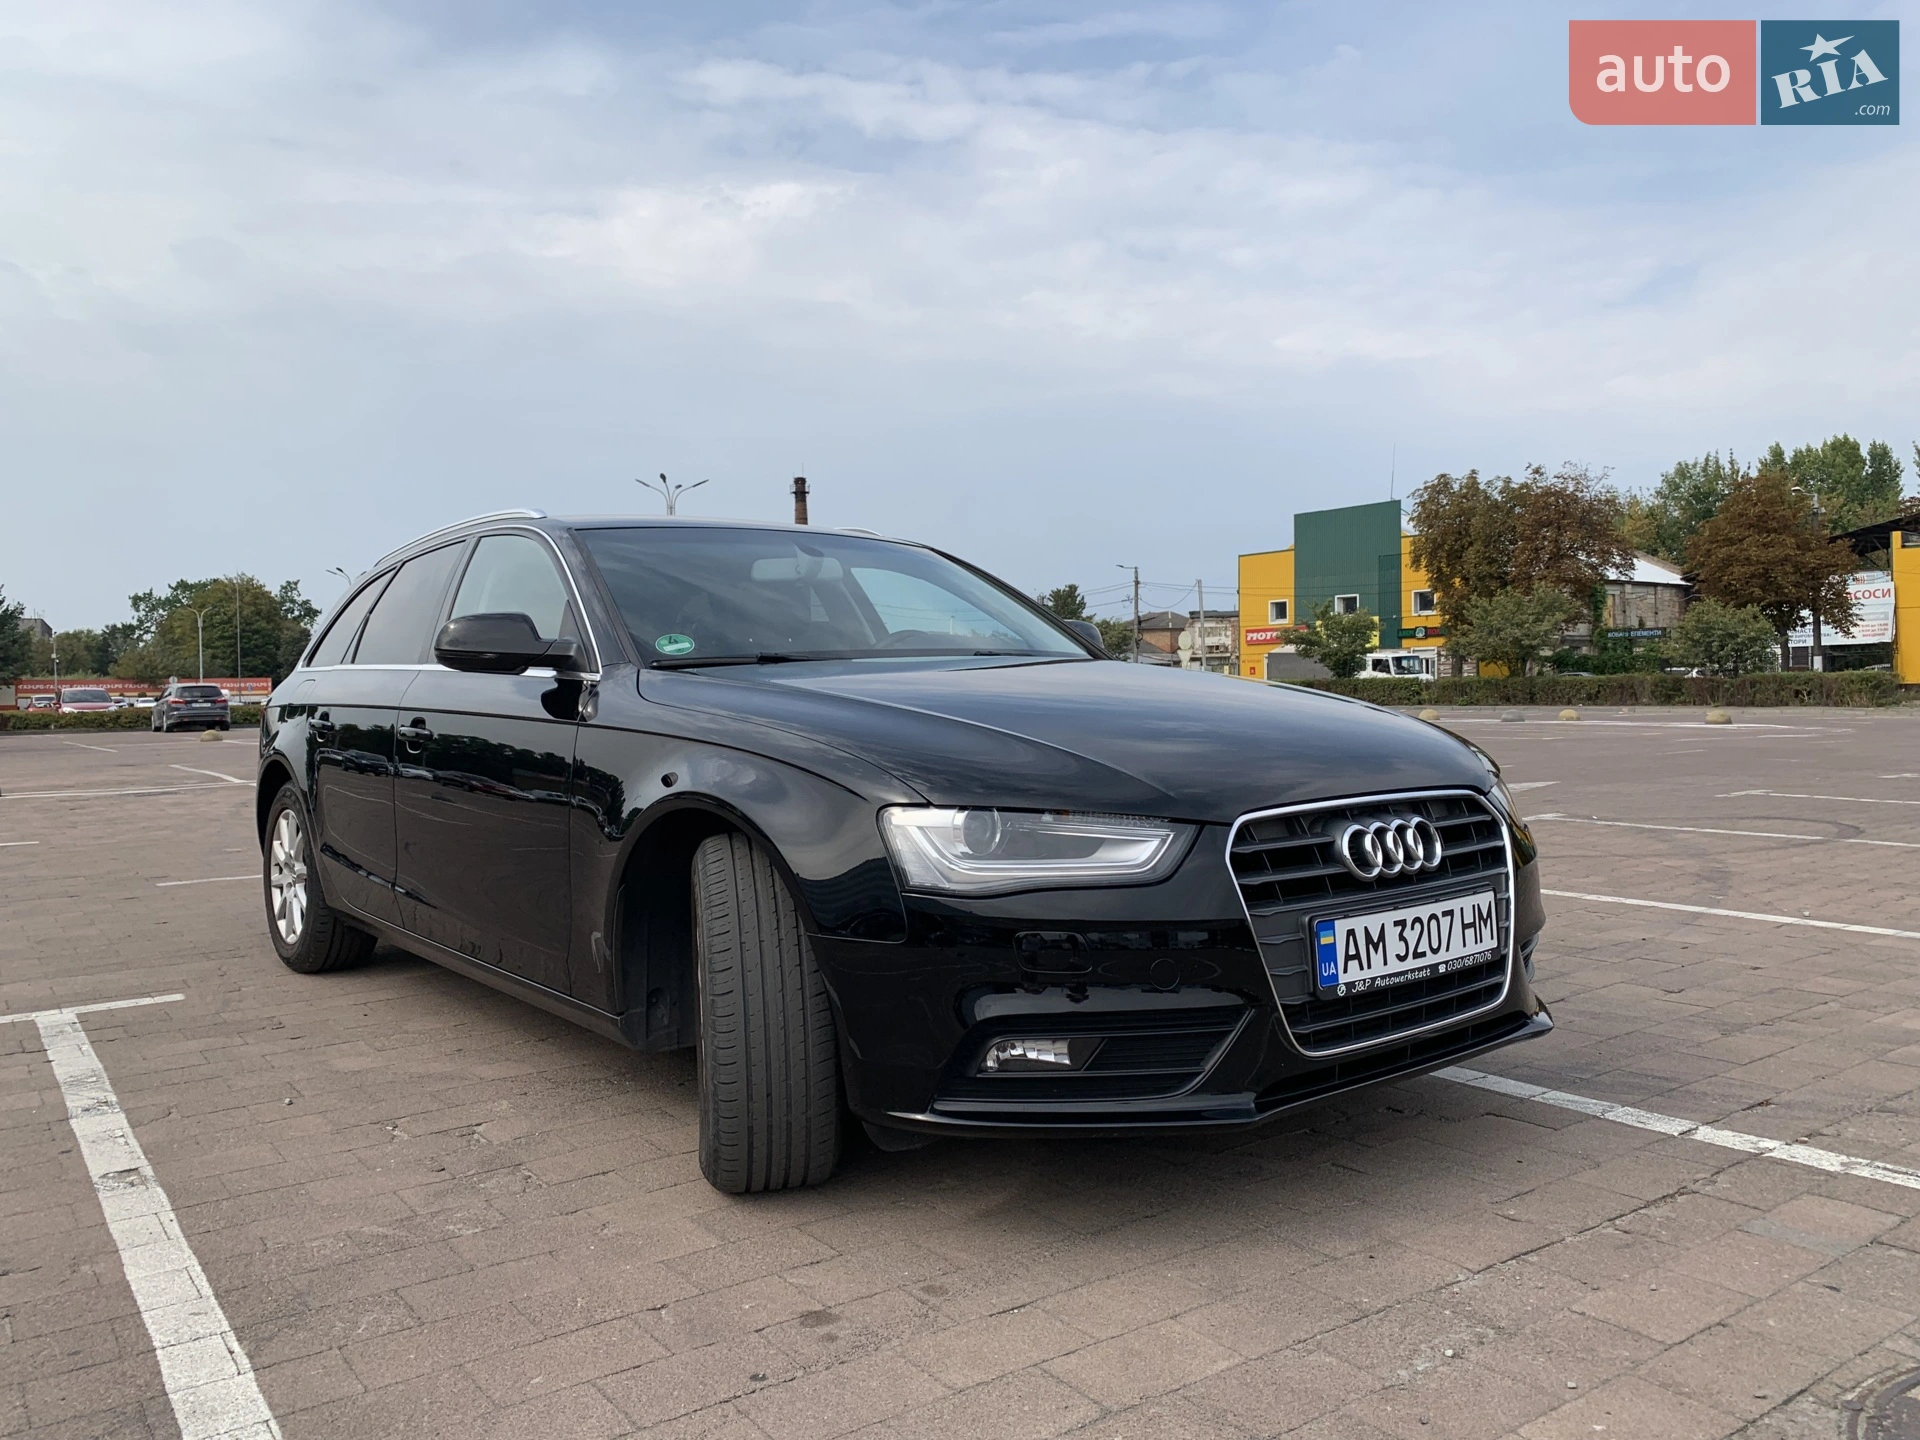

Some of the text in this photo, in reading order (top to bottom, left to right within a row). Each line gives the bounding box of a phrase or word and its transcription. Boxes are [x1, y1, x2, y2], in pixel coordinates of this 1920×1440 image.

[1343, 900, 1495, 974] AM 3207 HM
[1321, 961, 1337, 977] UA
[1351, 980, 1372, 993] J&P
[1374, 968, 1431, 988] Autowerkstatt
